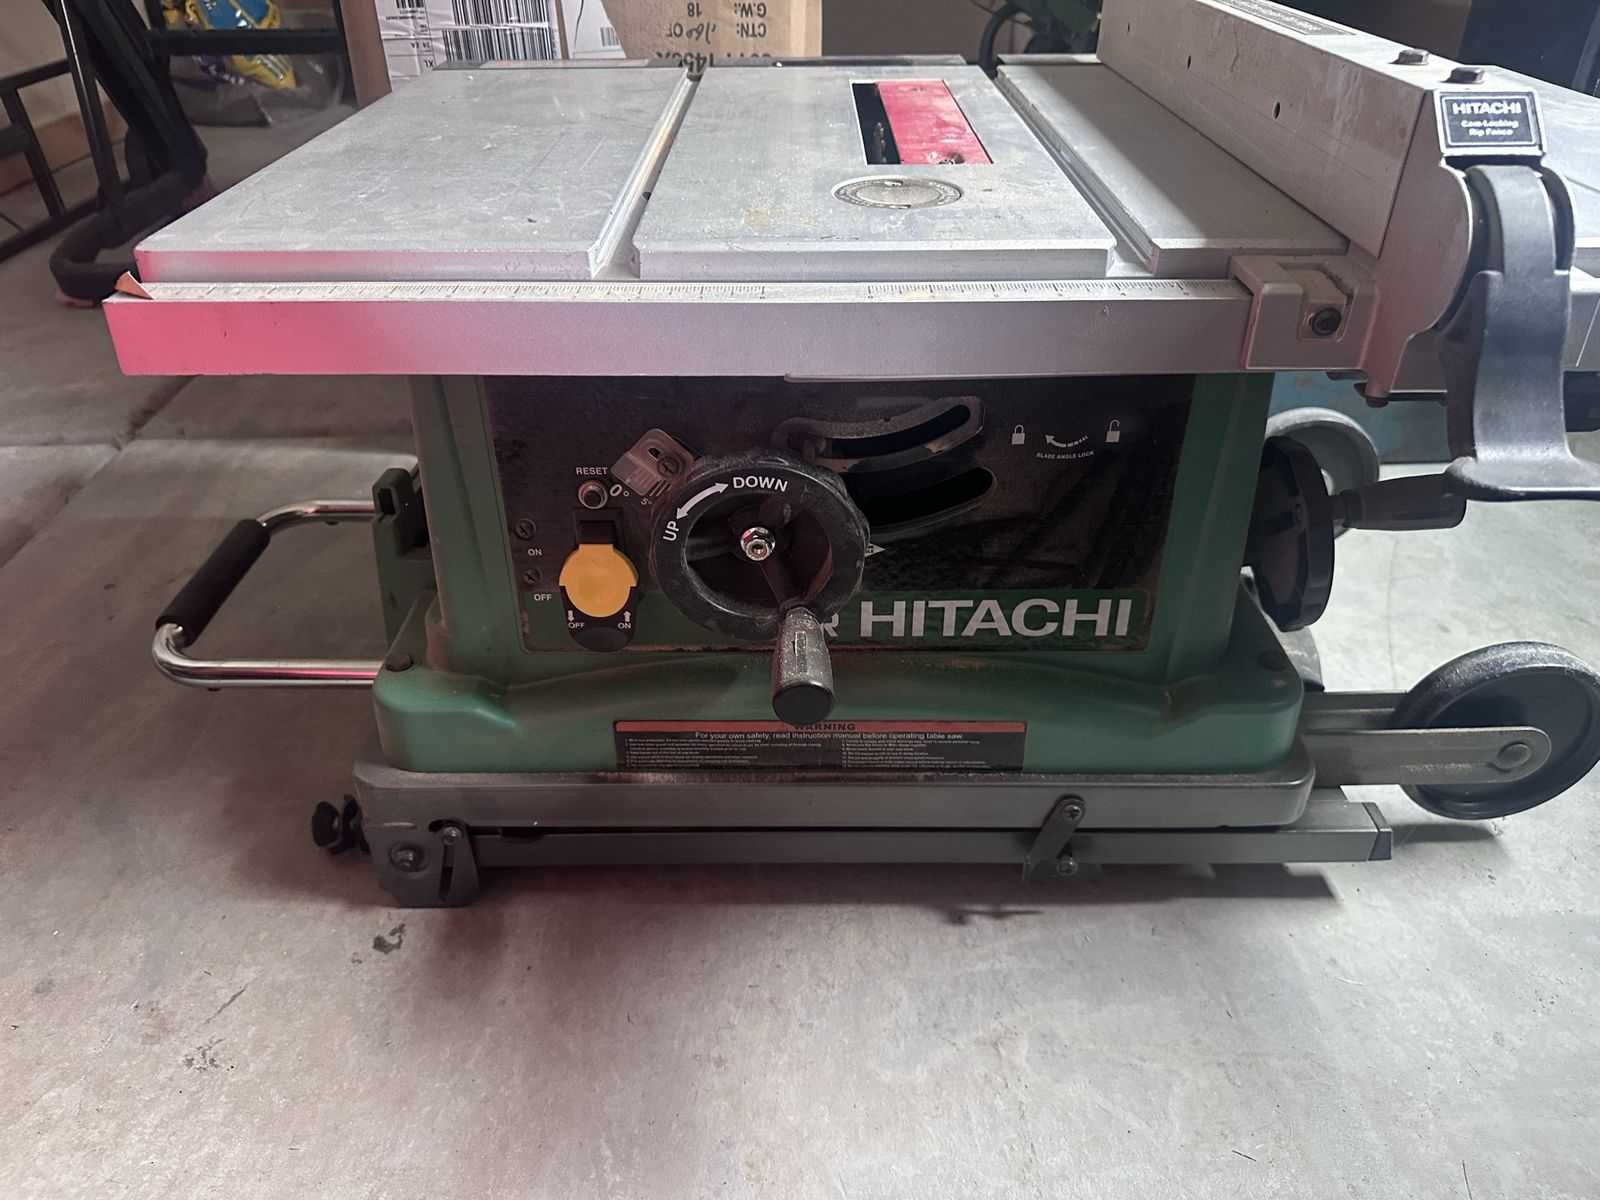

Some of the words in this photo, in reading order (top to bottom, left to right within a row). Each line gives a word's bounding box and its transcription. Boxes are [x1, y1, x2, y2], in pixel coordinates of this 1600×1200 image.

[687, 2, 702, 18] 18
[736, 23, 767, 38] CTN:
[1452, 102, 1522, 115] HITACHI
[1468, 128, 1485, 137] Rip
[1077, 450, 1095, 458] LOCK
[575, 466, 608, 475] RESET
[732, 475, 788, 492] DOWN
[662, 520, 680, 542] UP
[527, 548, 542, 556] ON
[533, 593, 552, 601] OFF
[860, 598, 1132, 637] HITACHI
[695, 731, 708, 739] For
[888, 733, 925, 741] operating
